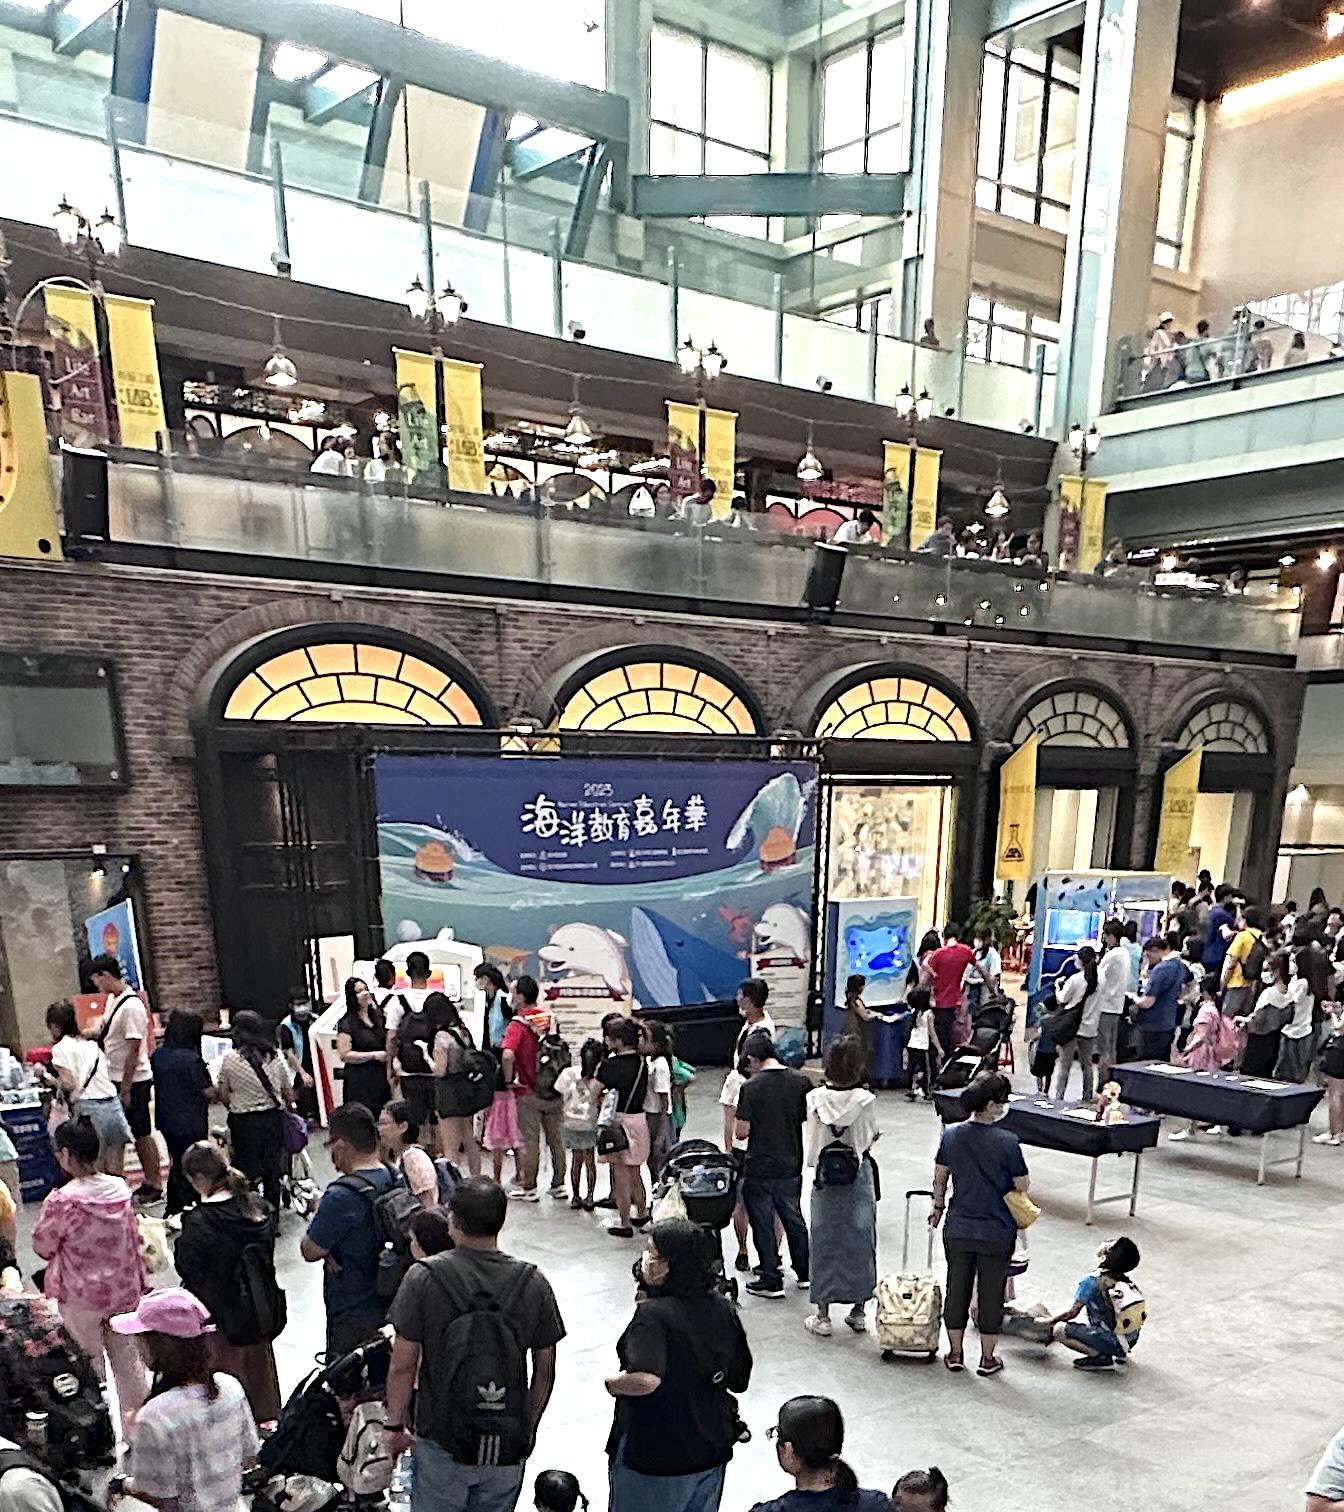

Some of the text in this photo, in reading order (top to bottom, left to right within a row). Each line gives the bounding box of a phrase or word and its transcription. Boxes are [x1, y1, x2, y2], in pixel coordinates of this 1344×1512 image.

[583, 783, 614, 797] 2023
[520, 793, 709, 848] 海洋教育嘉年華
